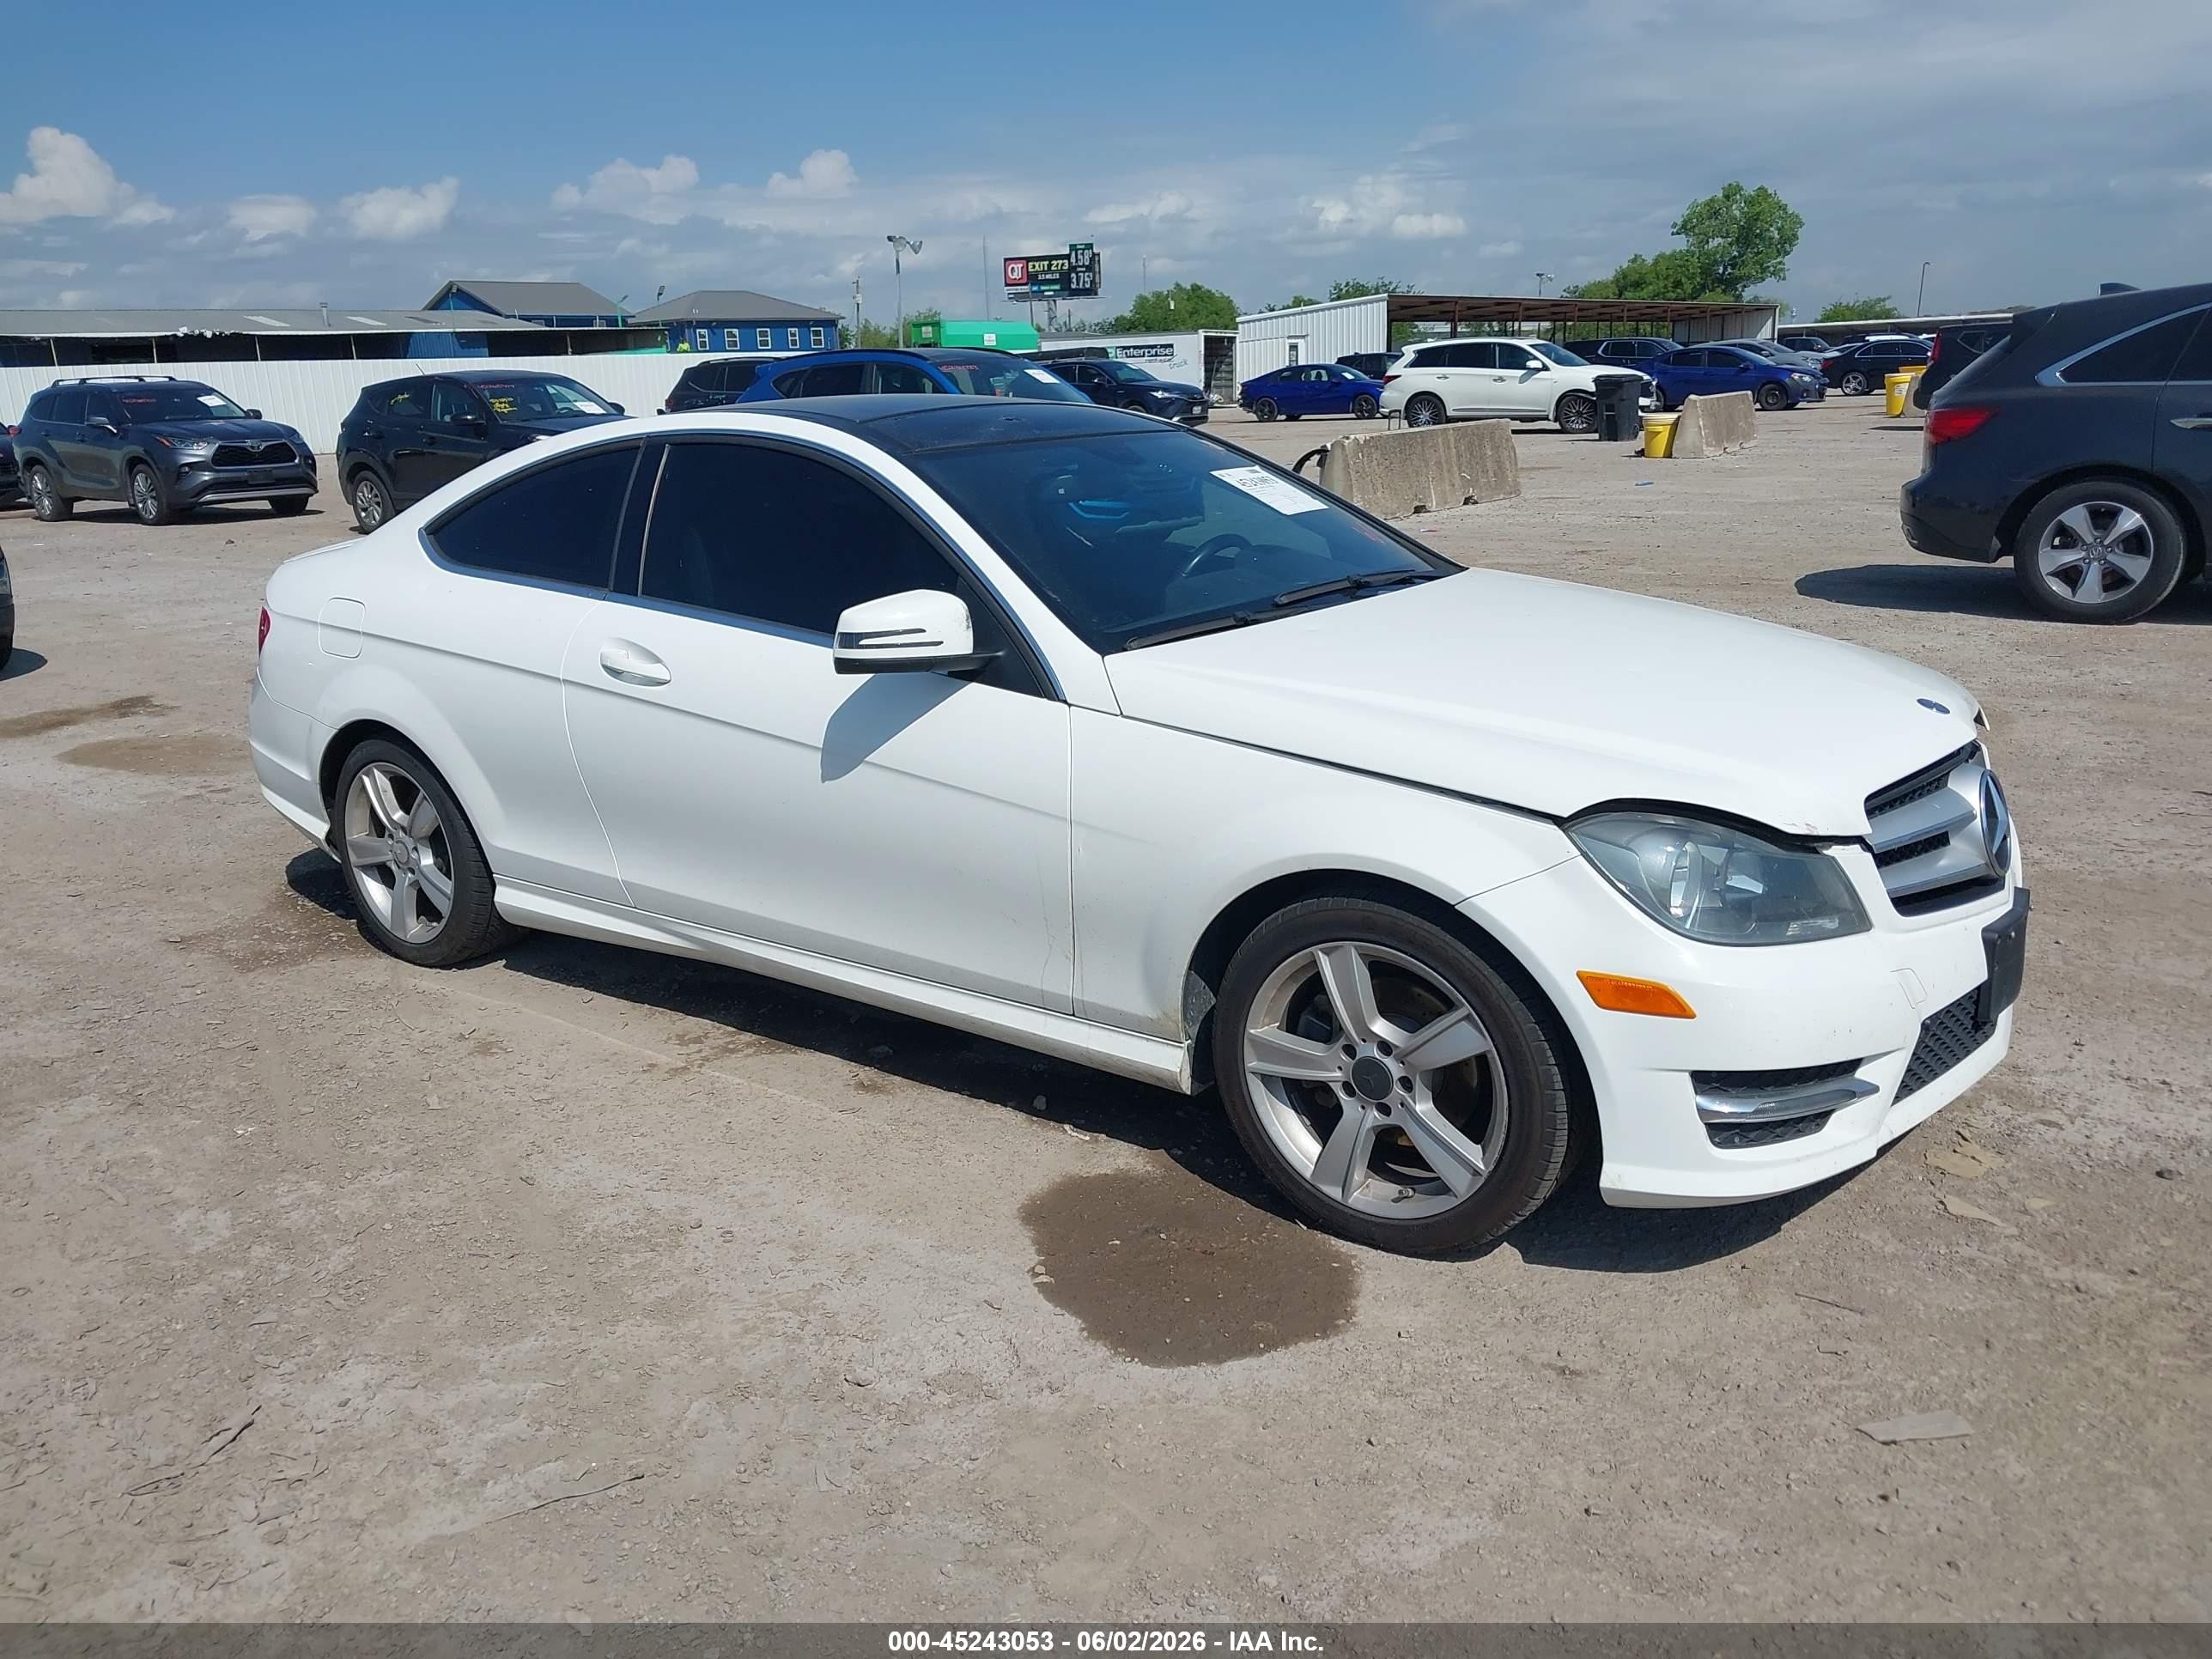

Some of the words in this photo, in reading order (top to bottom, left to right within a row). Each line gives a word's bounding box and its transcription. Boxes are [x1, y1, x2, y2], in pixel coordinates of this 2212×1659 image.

[1008, 264, 1023, 280] QT
[1028, 261, 1048, 272] EXIT
[1050, 259, 1069, 270] 273
[1116, 345, 1173, 358] Enterprise
